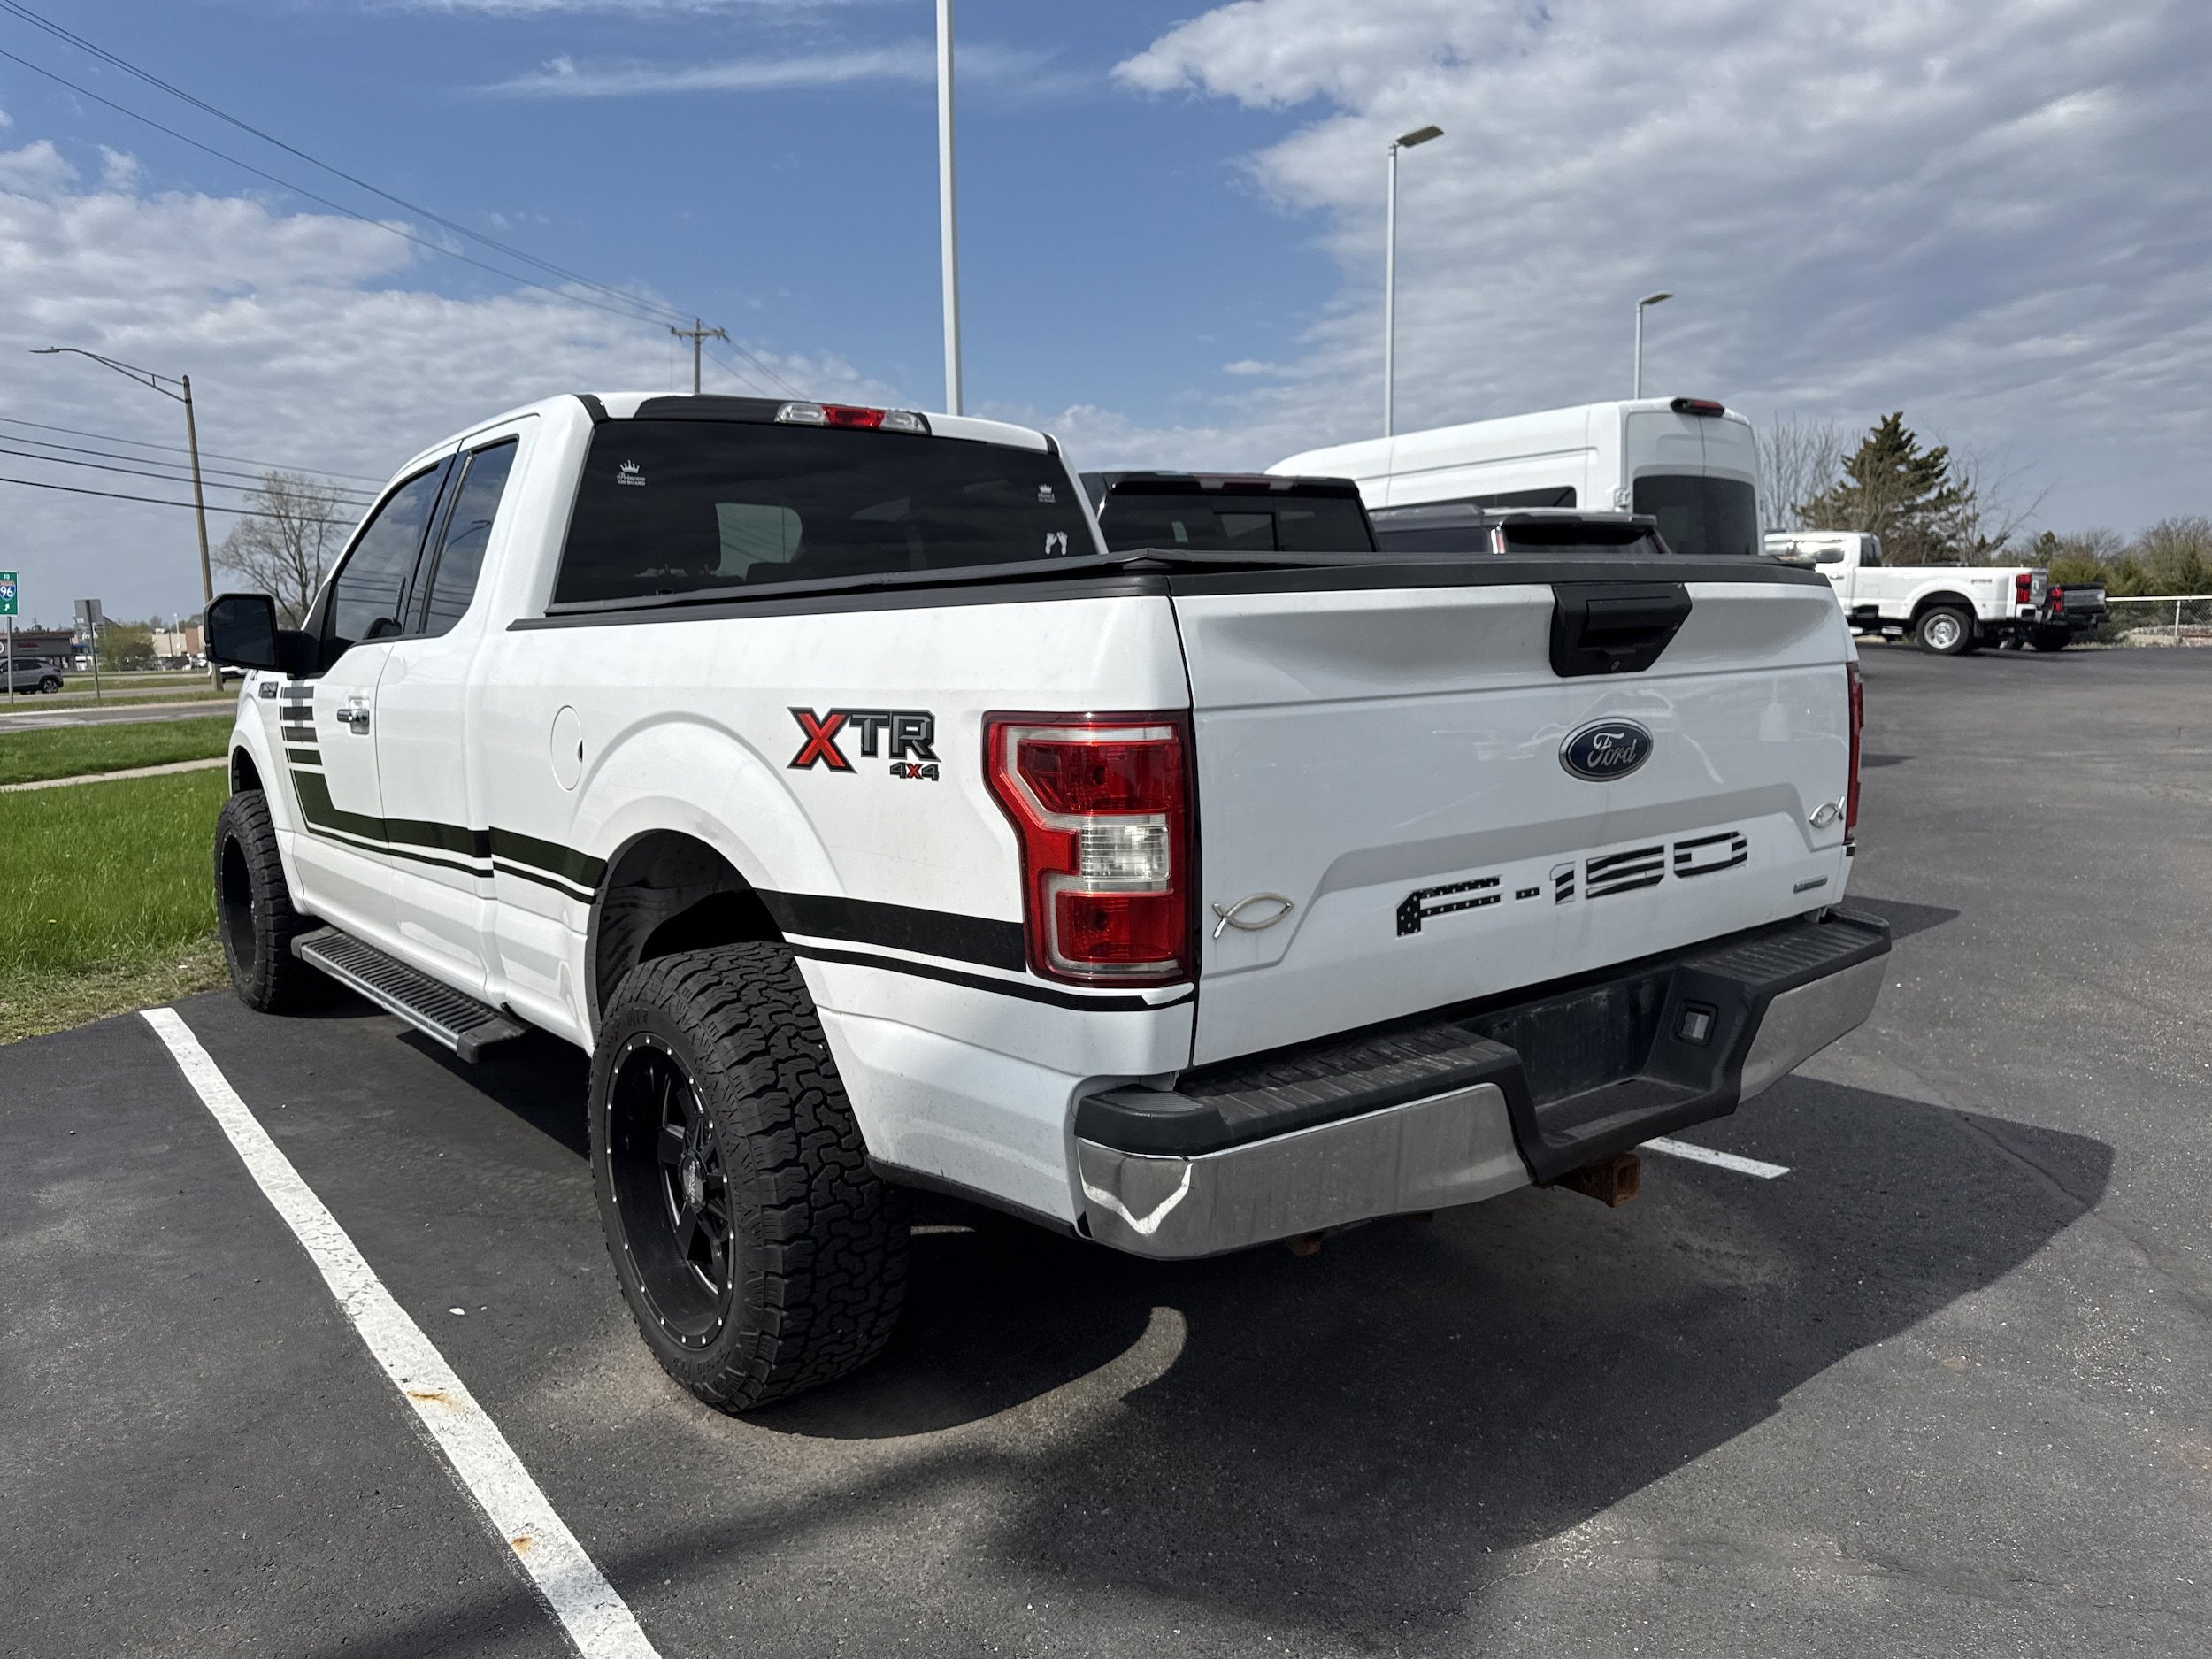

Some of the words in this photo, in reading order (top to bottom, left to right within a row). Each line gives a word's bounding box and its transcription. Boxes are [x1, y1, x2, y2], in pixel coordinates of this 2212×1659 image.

[0, 586, 13, 598] 96
[787, 706, 941, 774] XTR
[1586, 732, 1638, 769] Ford
[1396, 830, 1748, 939] F-150
